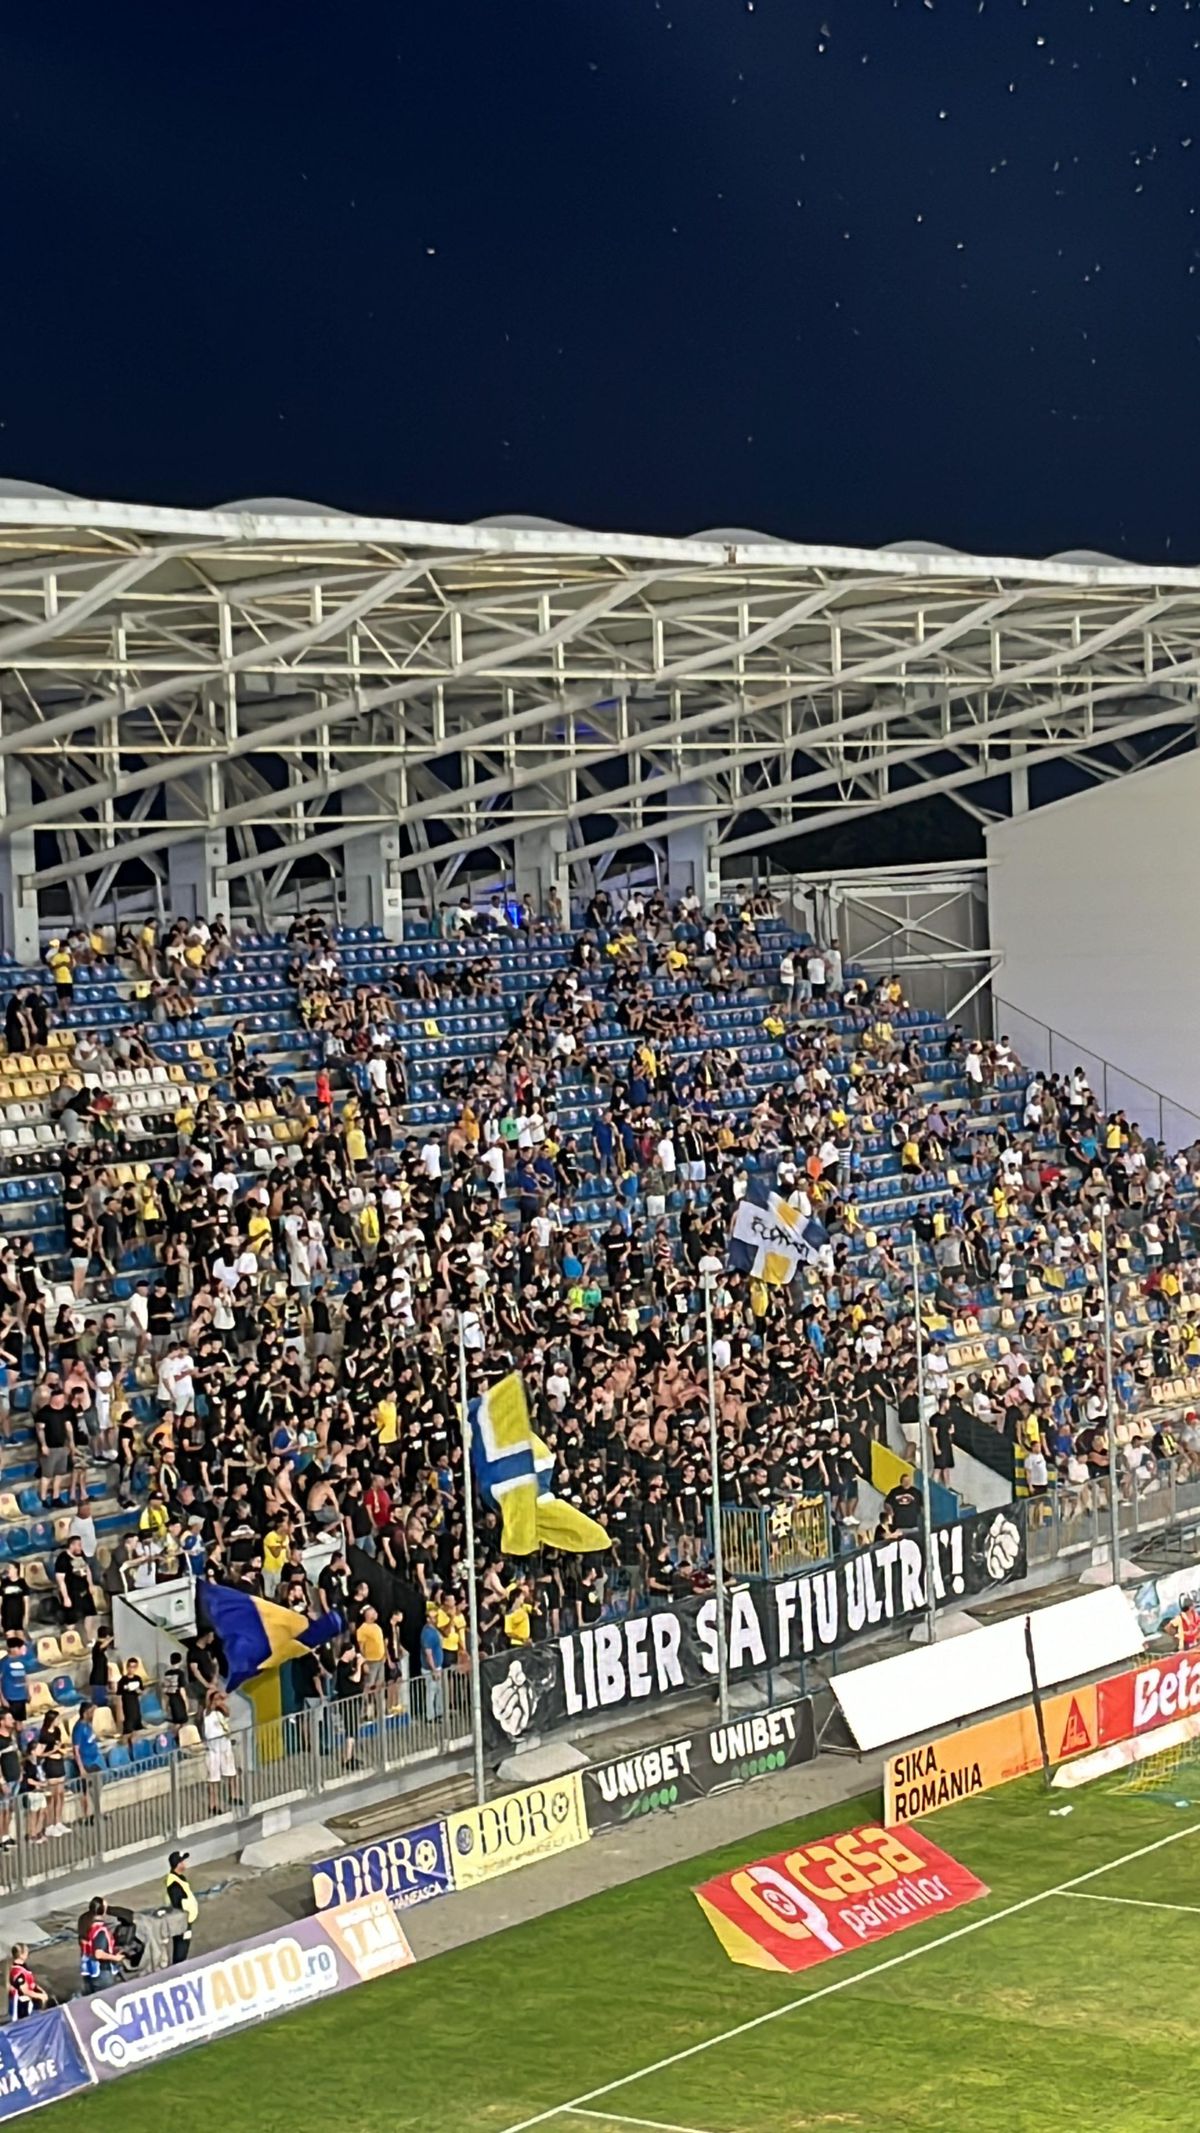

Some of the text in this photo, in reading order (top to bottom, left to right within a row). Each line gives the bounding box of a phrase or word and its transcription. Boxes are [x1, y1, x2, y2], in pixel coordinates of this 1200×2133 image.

[560, 1613, 684, 1715] LIBER
[696, 1583, 767, 1673] SĂ
[775, 1570, 838, 1658] FIU
[710, 1707, 796, 1765] UNIBET
[894, 1746, 938, 1788] SIKA
[597, 1740, 692, 1802] UNIBET
[895, 1762, 983, 1823] ROMÂNIA
[784, 1827, 927, 1901] casa
[839, 1873, 953, 1939] pariurilor
